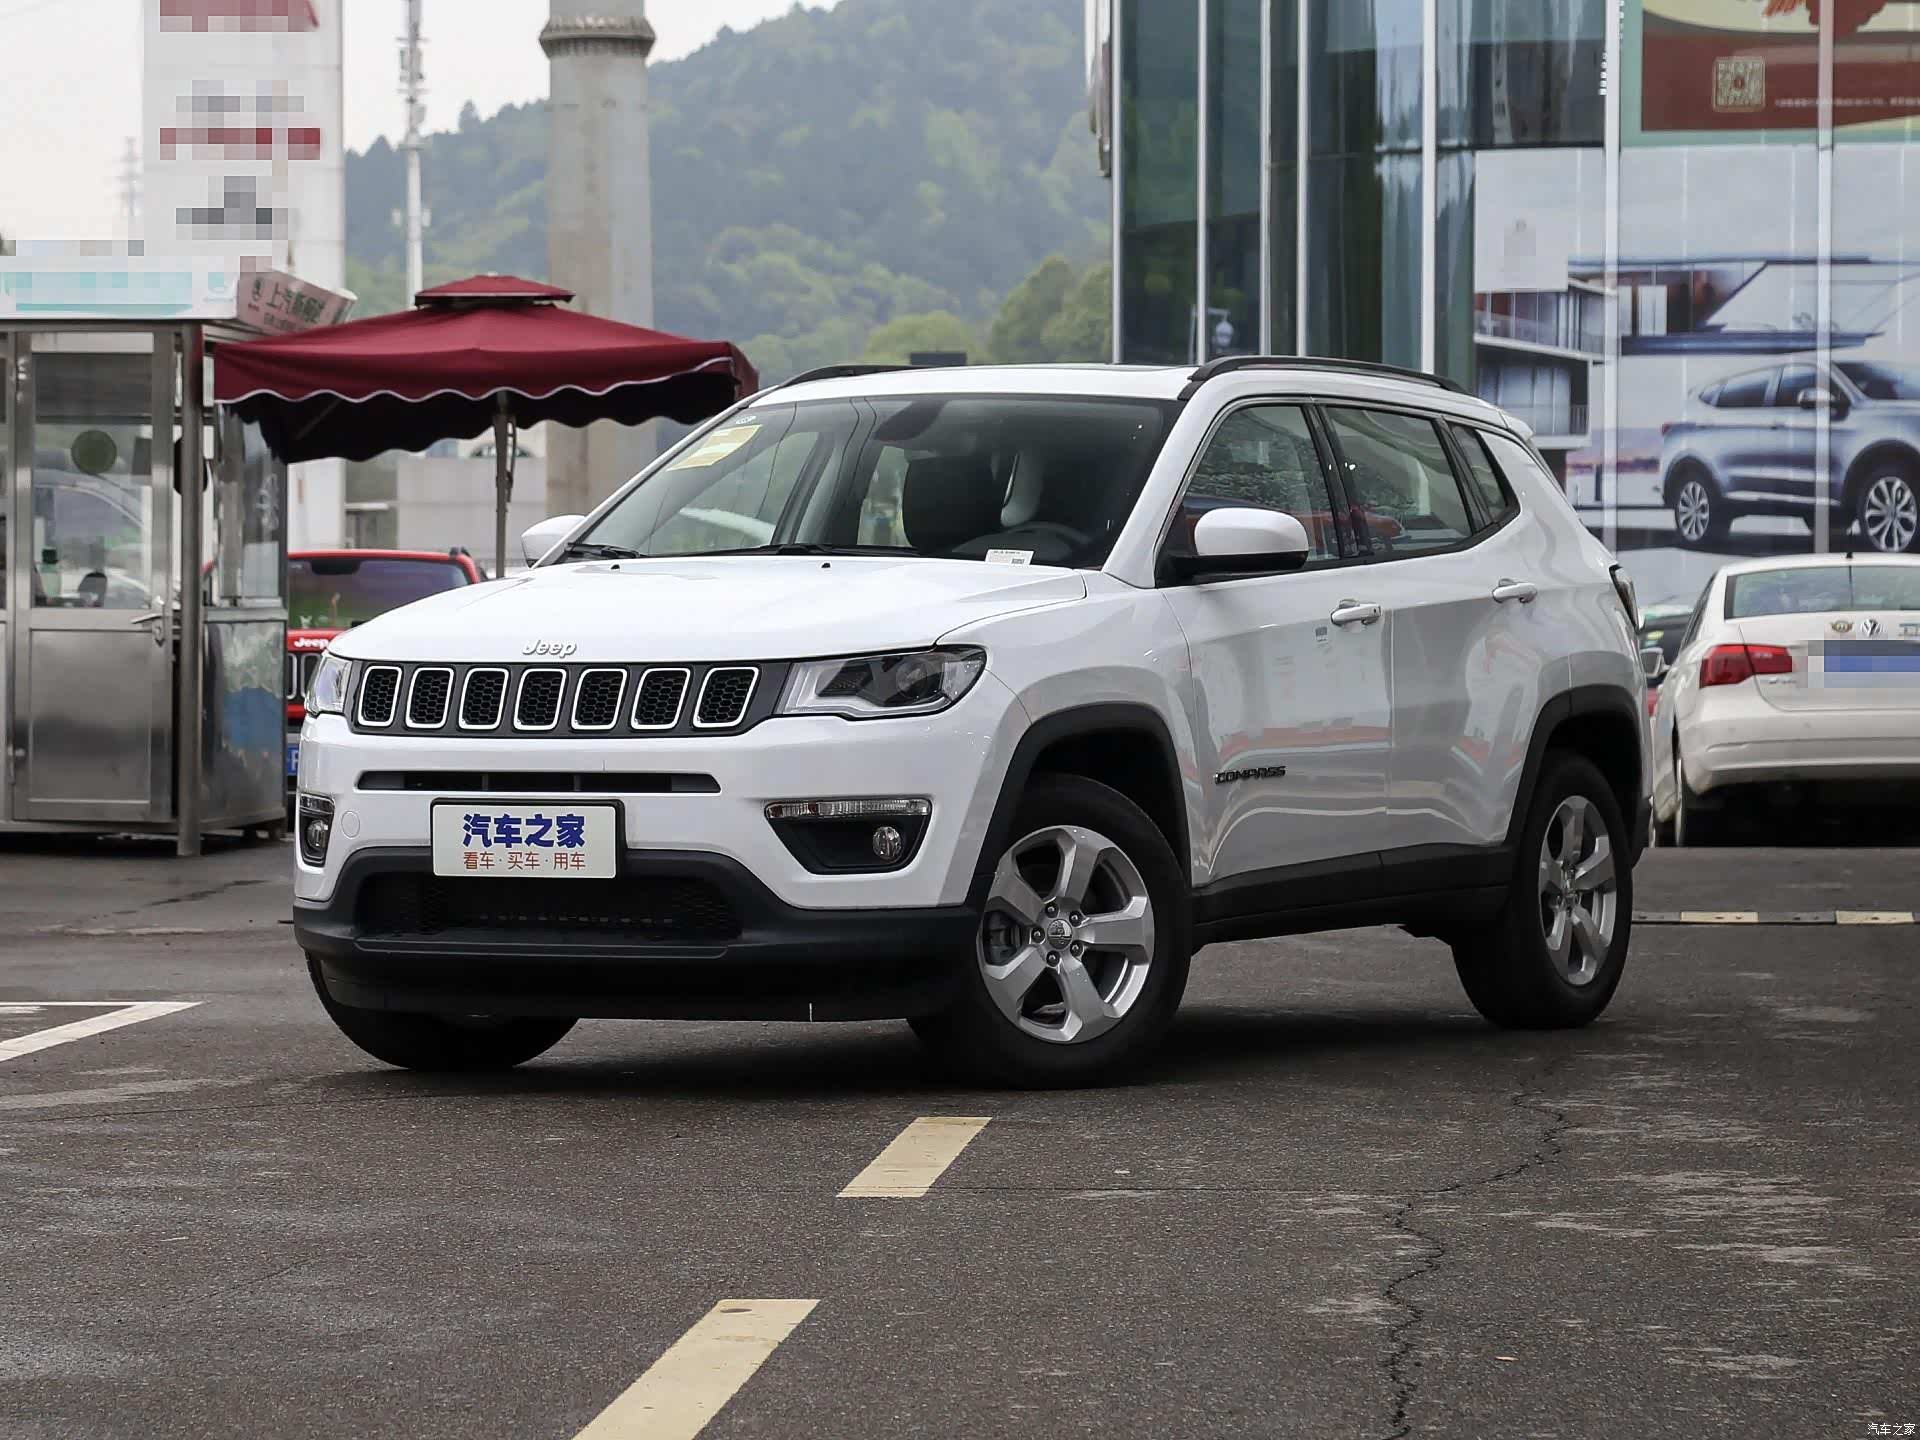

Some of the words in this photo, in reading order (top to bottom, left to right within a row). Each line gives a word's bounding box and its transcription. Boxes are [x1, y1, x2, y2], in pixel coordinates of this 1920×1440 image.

[294, 637, 329, 650] Jeep
[522, 640, 578, 658] Jeep
[1215, 766, 1287, 785] COMPASS
[462, 813, 586, 849] 汽车之家
